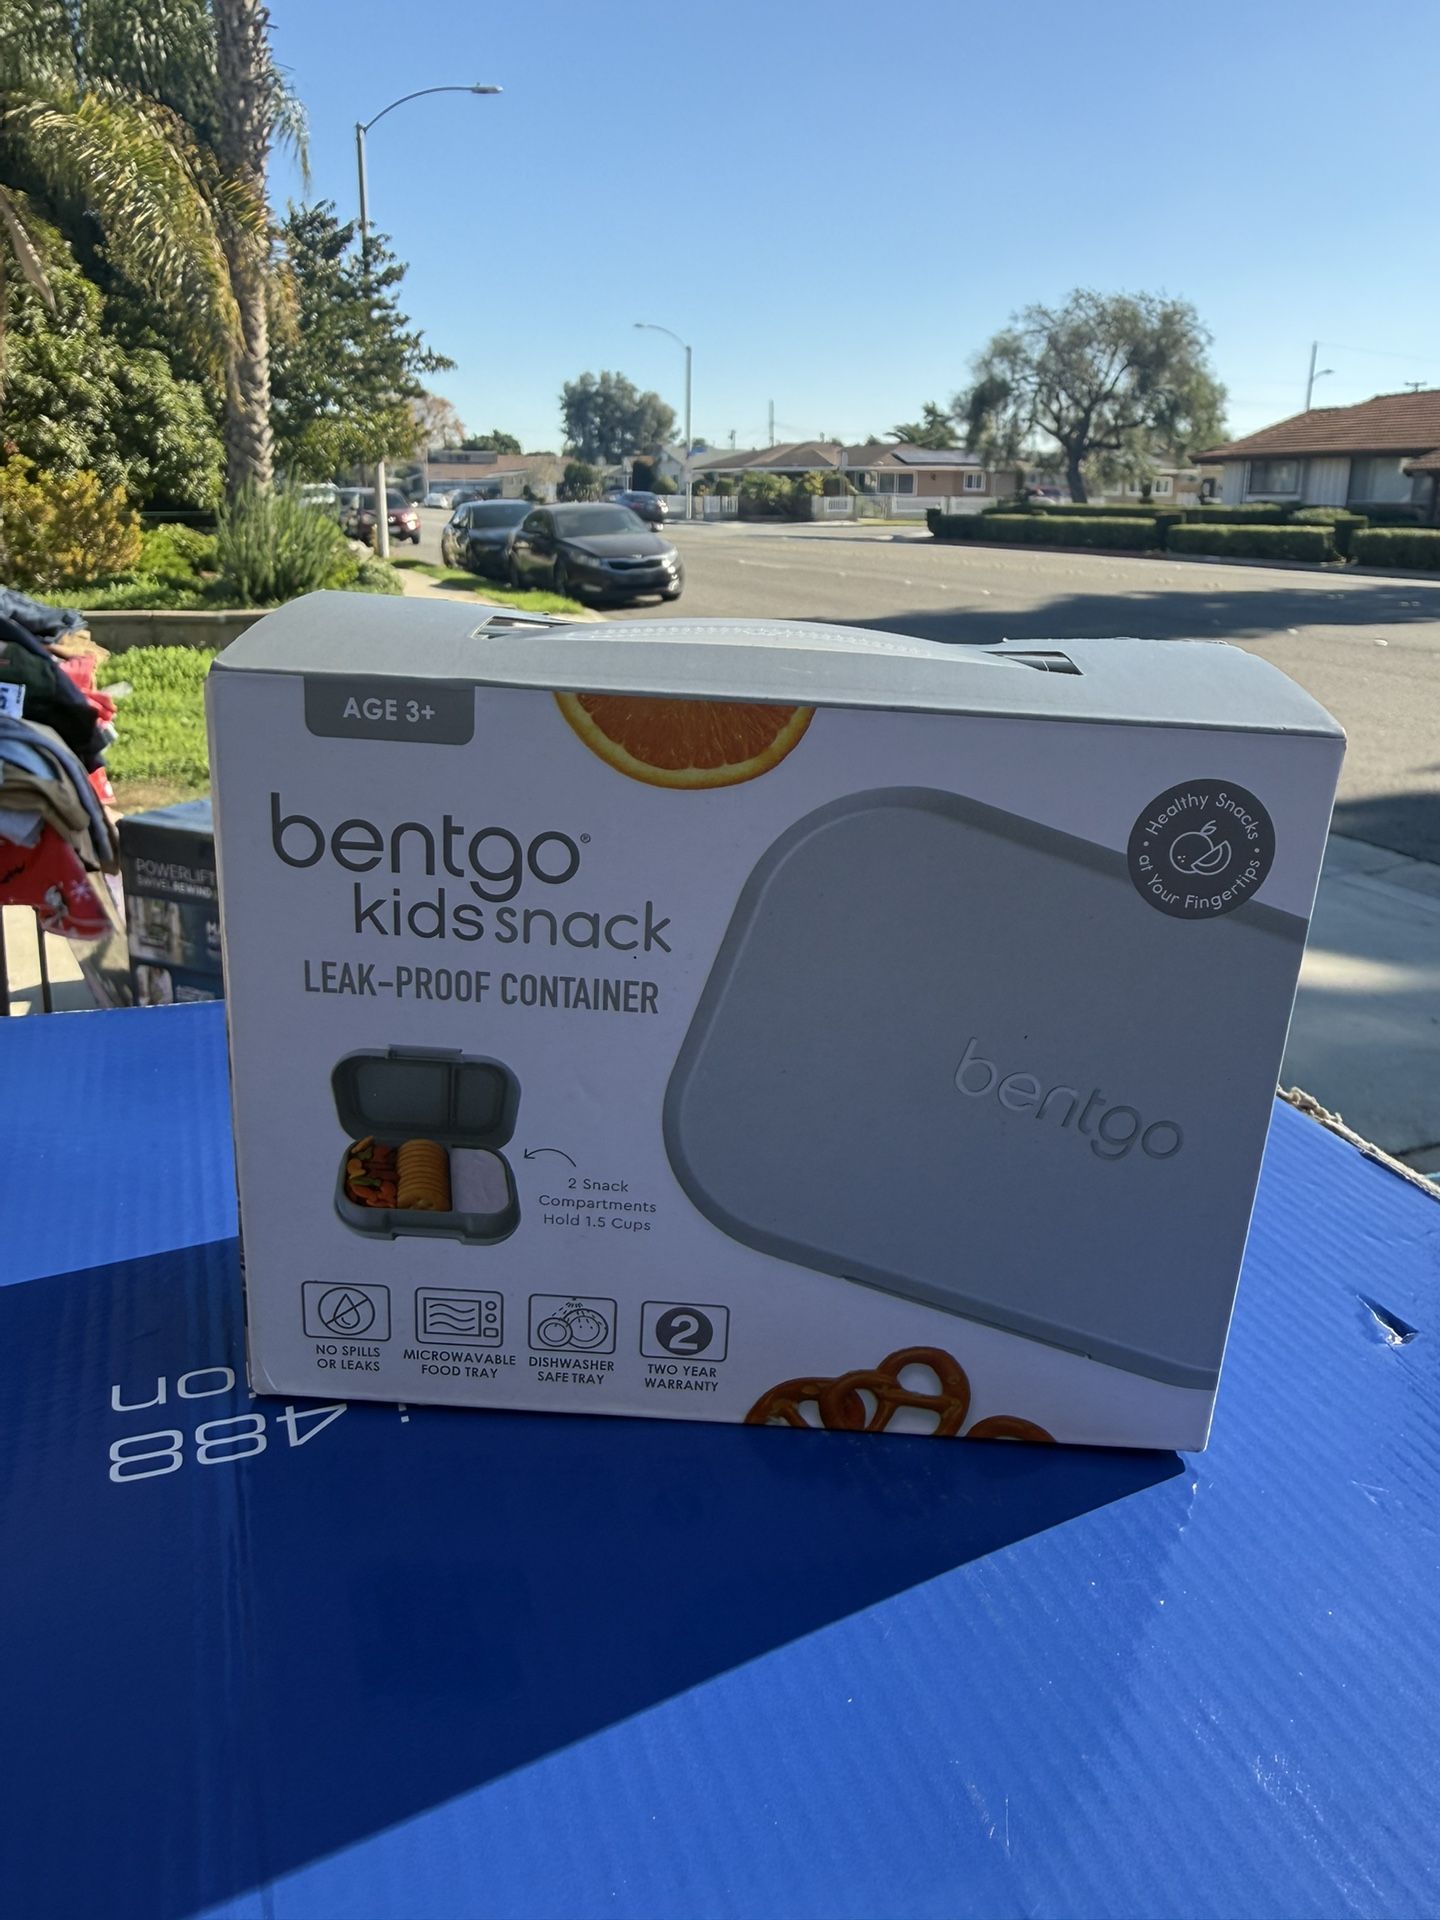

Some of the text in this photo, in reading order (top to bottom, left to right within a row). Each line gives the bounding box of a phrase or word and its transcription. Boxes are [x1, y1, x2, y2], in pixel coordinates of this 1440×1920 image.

[343, 696, 436, 723] AGE 3+
[1145, 792, 1260, 840] Healthy Snacks
[1138, 854, 1261, 910] at Your Fingertips
[353, 881, 672, 954] kids snack
[304, 959, 659, 1014] LEAK-PROOF CONTAINER
[954, 1036, 1184, 1161] bentgo
[568, 1177, 629, 1193] 2 Snack
[538, 1194, 657, 1213] Compartments
[544, 1213, 651, 1232] Hold 1.5 Cups
[668, 1314, 700, 1350] 2
[315, 1344, 381, 1358] NO SPILLS
[402, 1348, 517, 1366] MICROWAVABLE
[316, 1358, 381, 1372] OR LEAKS
[421, 1364, 498, 1379] FOOD TRAY
[528, 1356, 615, 1372] DISHWASHER
[647, 1363, 717, 1378] TWO YEAR
[644, 1377, 719, 1392] WARRANTY
[109, 1402, 348, 1483] 488
